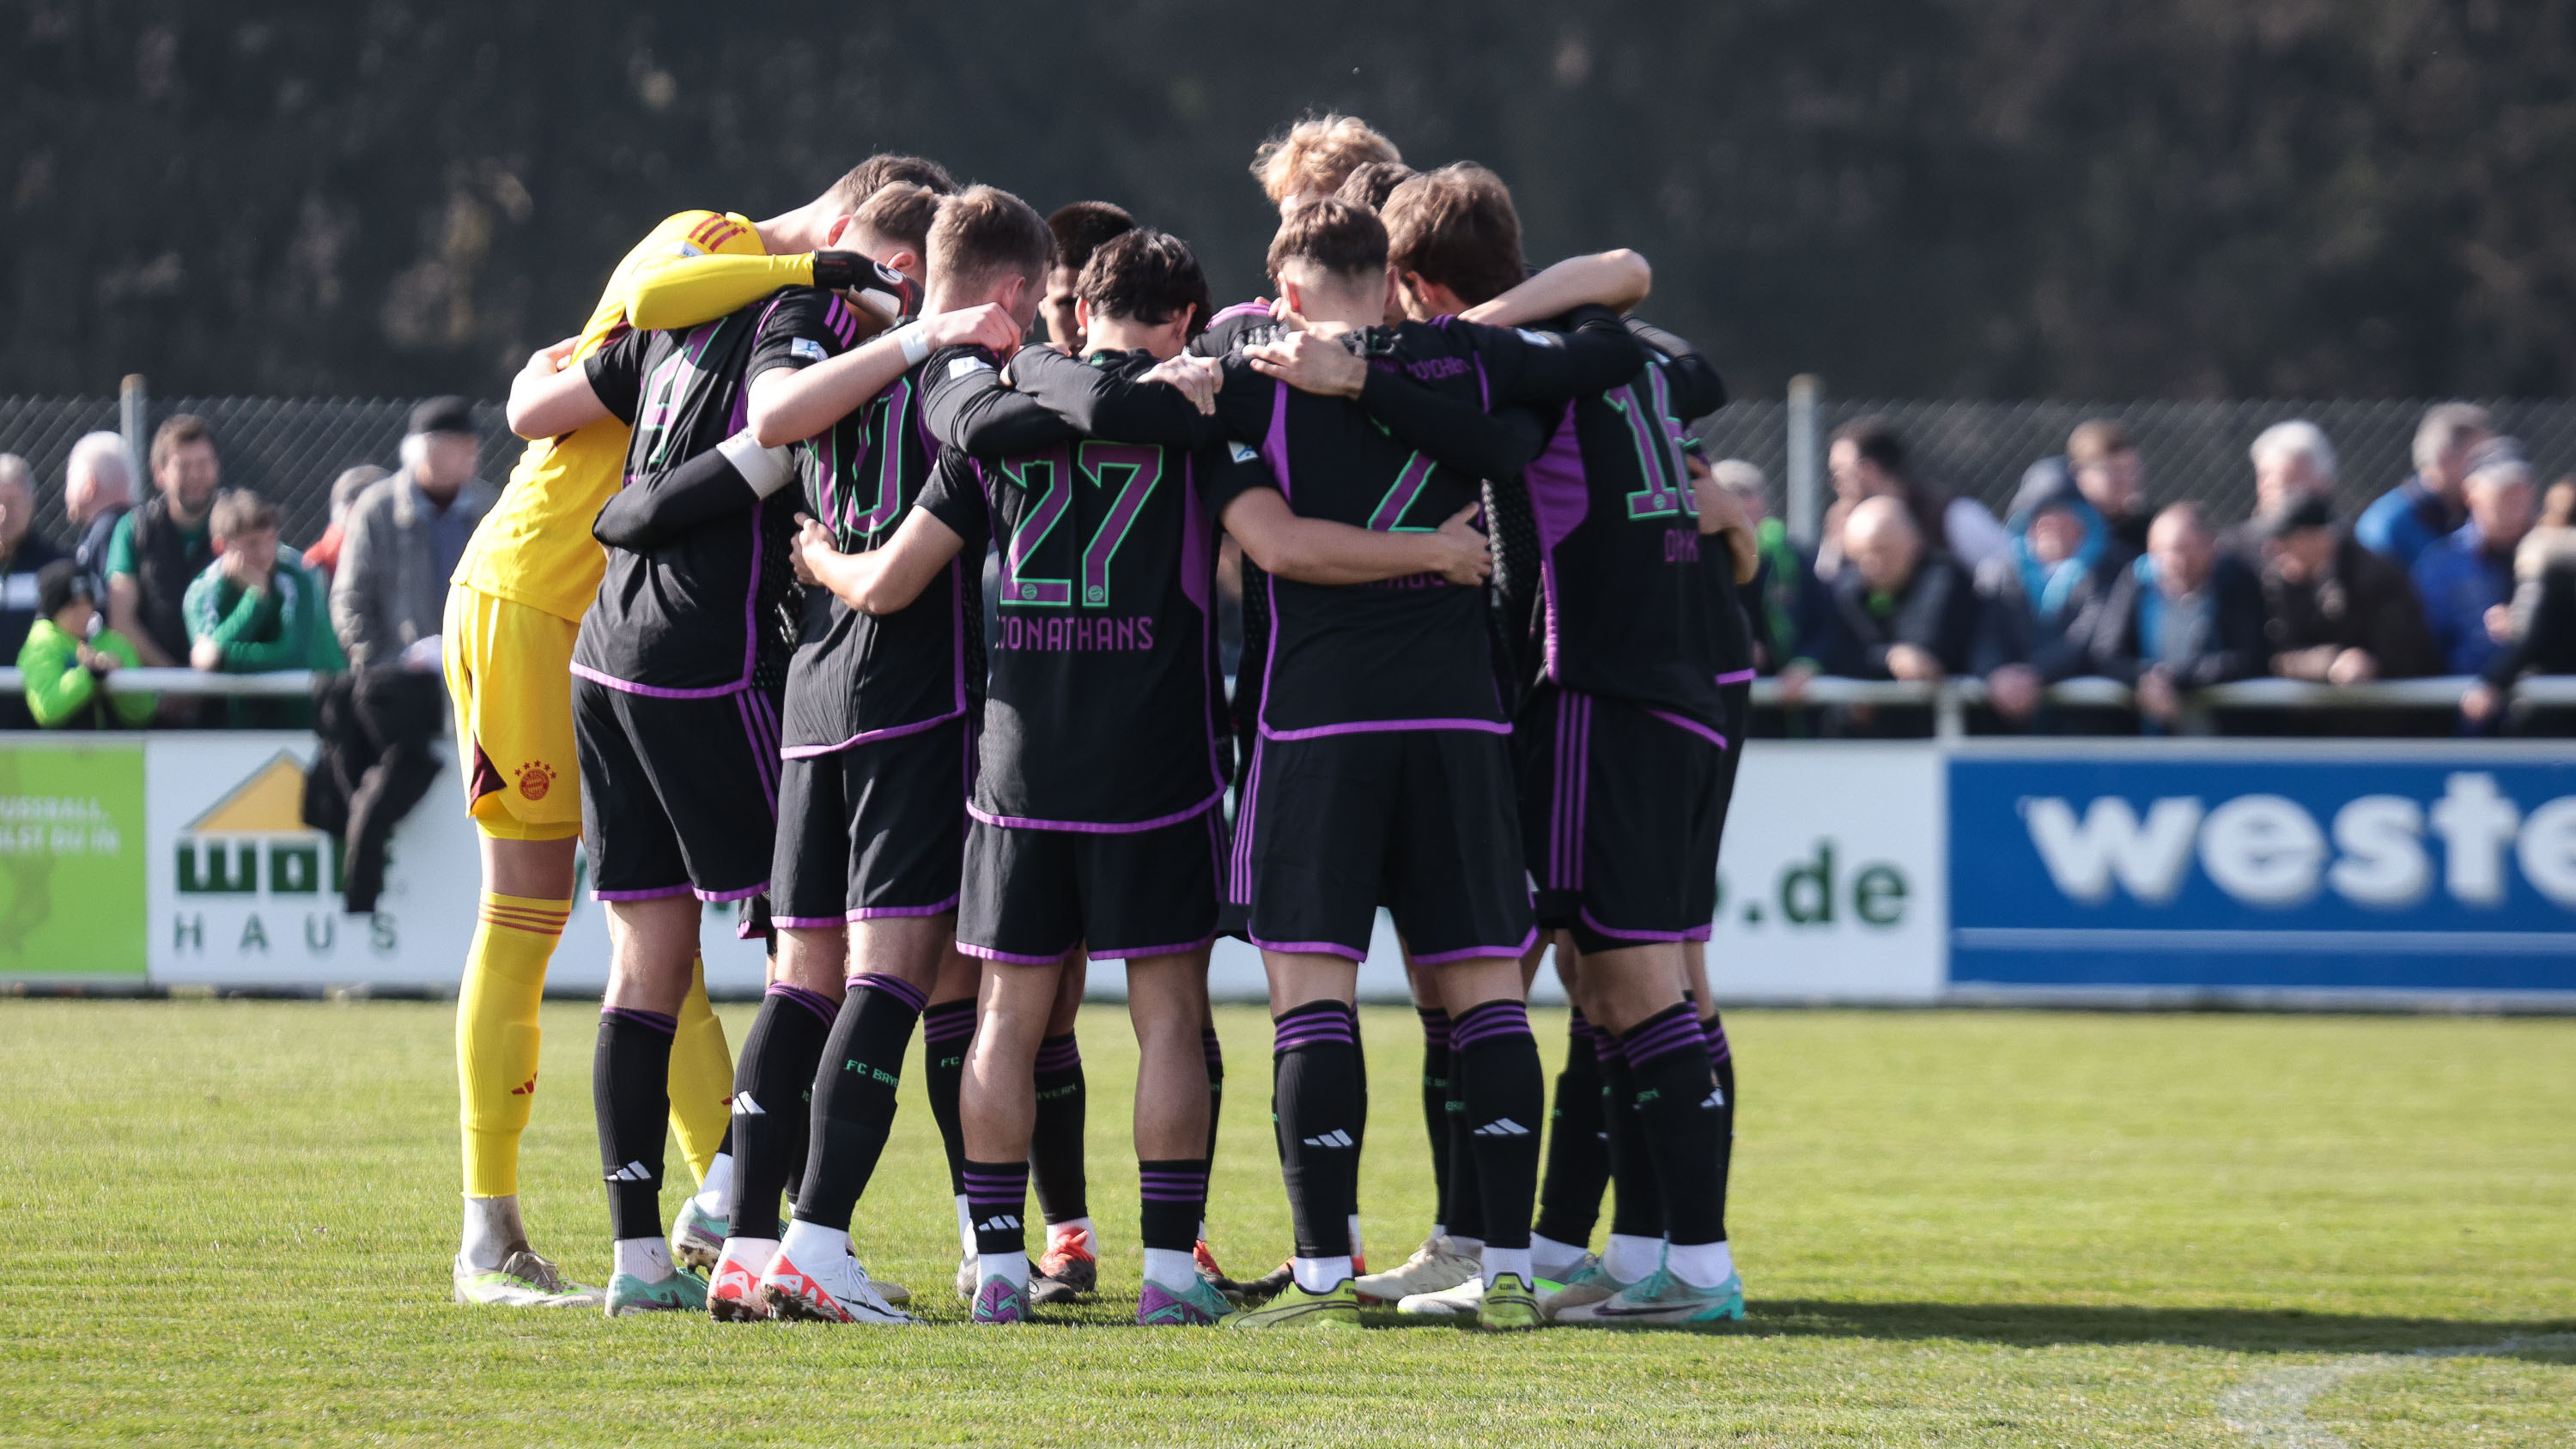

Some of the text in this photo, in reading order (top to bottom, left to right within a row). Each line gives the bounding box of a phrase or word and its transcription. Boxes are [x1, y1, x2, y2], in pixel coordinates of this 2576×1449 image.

[999, 440, 1163, 607] 27
[999, 615, 1154, 651] JONATHANS
[1716, 835, 1909, 925] .de
[173, 911, 397, 949] HAUS
[845, 1058, 867, 1075] FC
